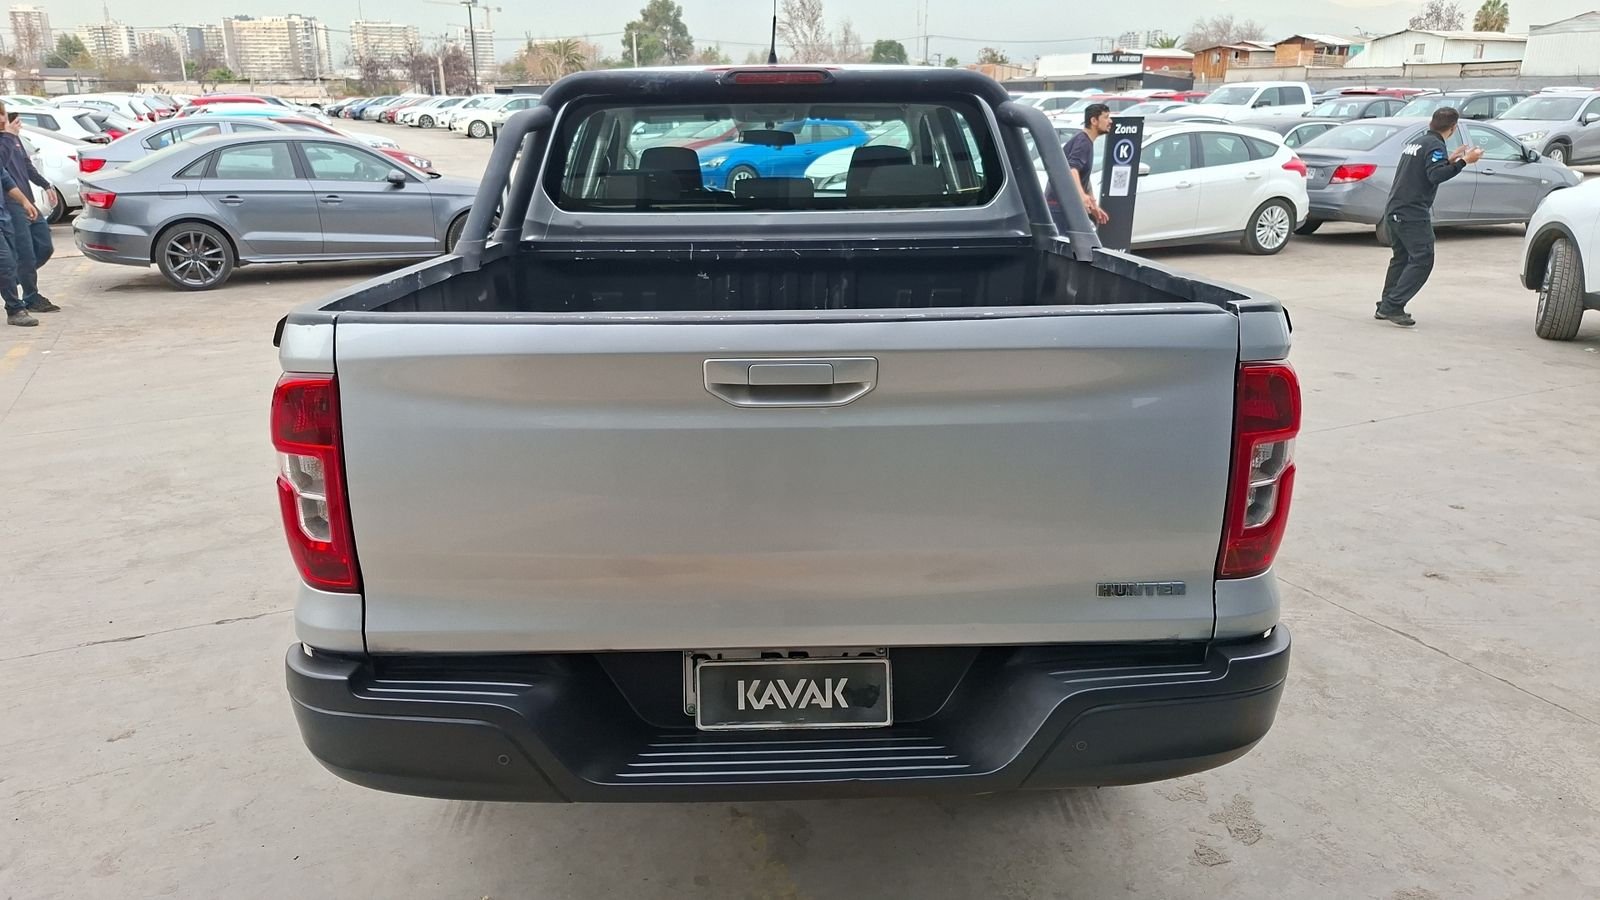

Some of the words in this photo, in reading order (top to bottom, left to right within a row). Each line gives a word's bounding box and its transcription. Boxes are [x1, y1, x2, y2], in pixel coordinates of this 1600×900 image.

[1114, 124, 1138, 134] Zona
[1119, 144, 1129, 158] K
[1096, 581, 1186, 597] HUNTER
[737, 678, 849, 710] KAVAK
